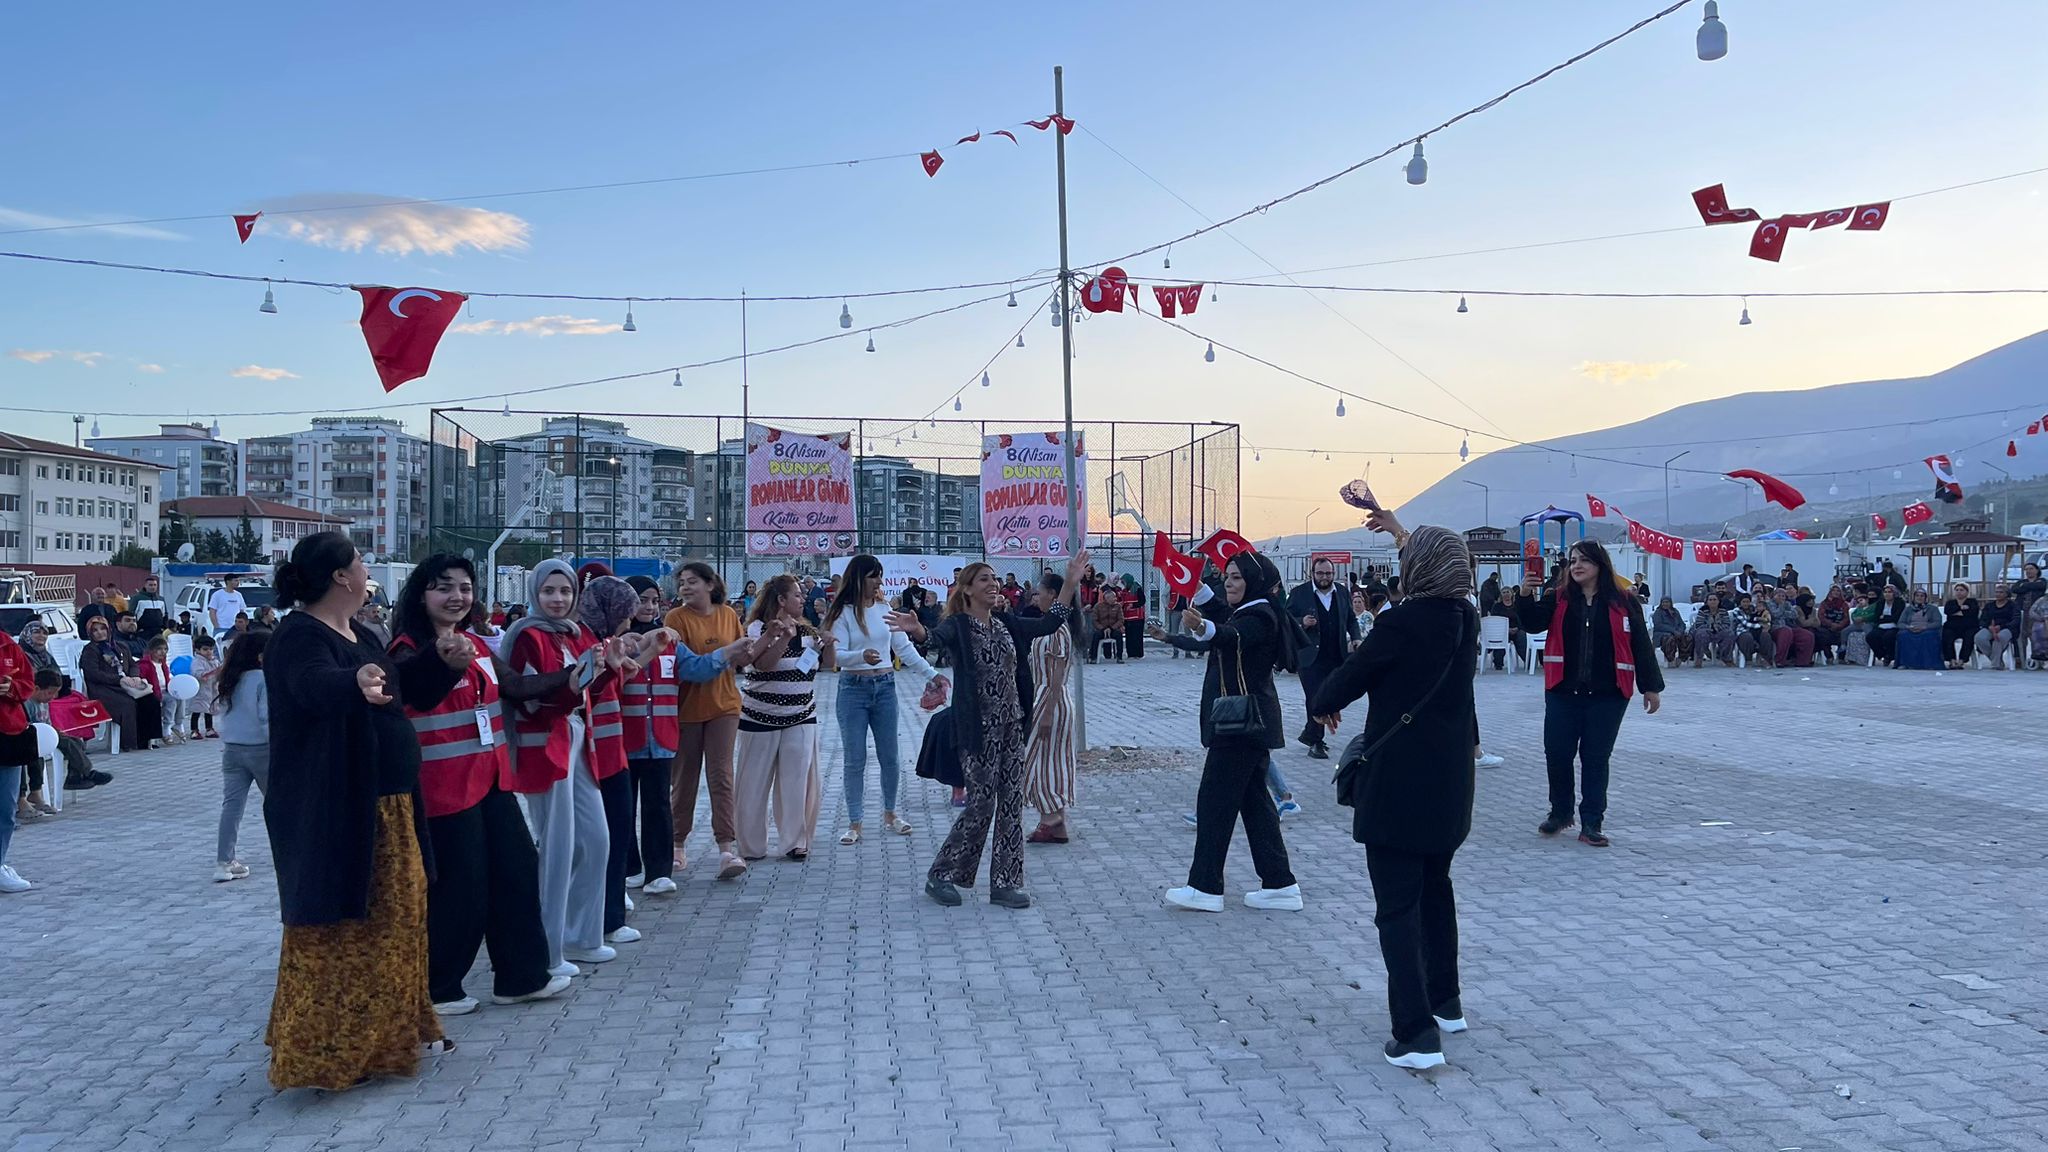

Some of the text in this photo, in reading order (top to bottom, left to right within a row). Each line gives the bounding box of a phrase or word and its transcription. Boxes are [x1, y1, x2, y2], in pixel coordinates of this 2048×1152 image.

[774, 443, 827, 459] 8 Nisan
[1006, 447, 1058, 463] 8 Nisan
[769, 459, 832, 475] DÜNYA
[1002, 463, 1064, 480] DÜNYA
[751, 475, 849, 507] ROMANLAR GÜNÜ
[985, 482, 1048, 513] ROMANLAR
[807, 511, 839, 527] Olsun
[918, 575, 949, 586] GÜNÜ
